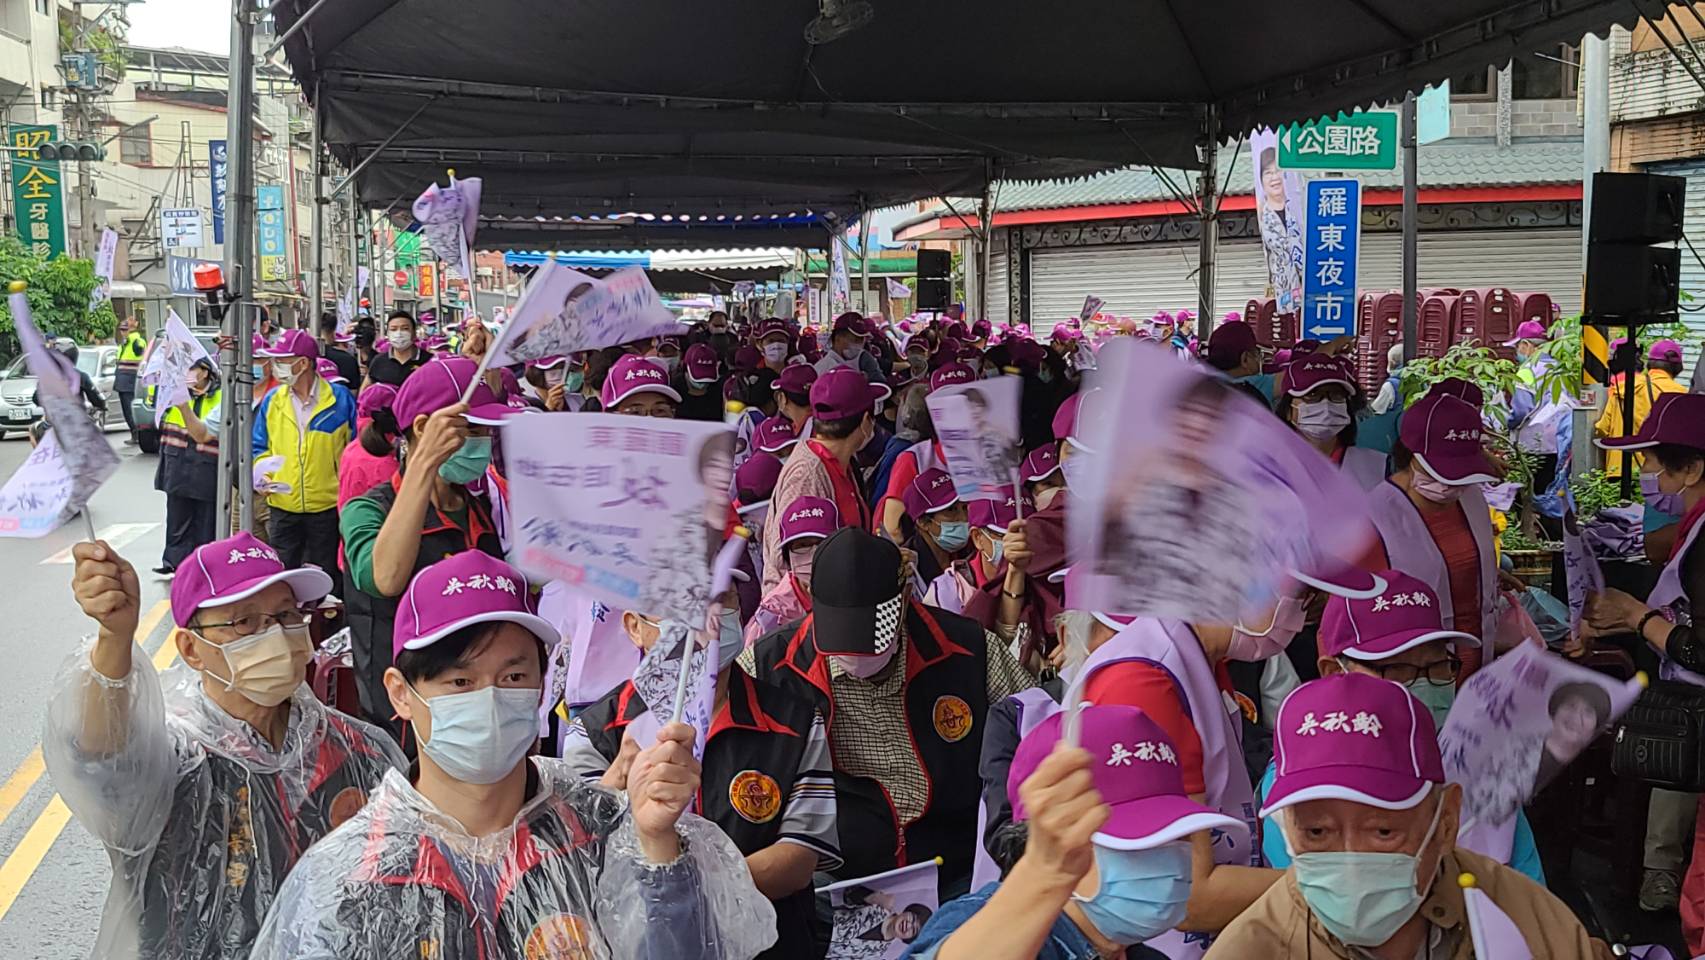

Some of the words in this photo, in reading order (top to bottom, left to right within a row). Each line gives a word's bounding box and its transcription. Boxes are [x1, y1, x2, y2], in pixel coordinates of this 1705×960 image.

[1297, 126, 1381, 156] 公園路
[1316, 187, 1347, 320] 羅東夜市
[442, 574, 518, 597] 吳秋齡
[1371, 591, 1431, 612] 吳秋齡
[1296, 711, 1383, 738] 吳秋齡
[1106, 741, 1177, 766] 吳秋齡
